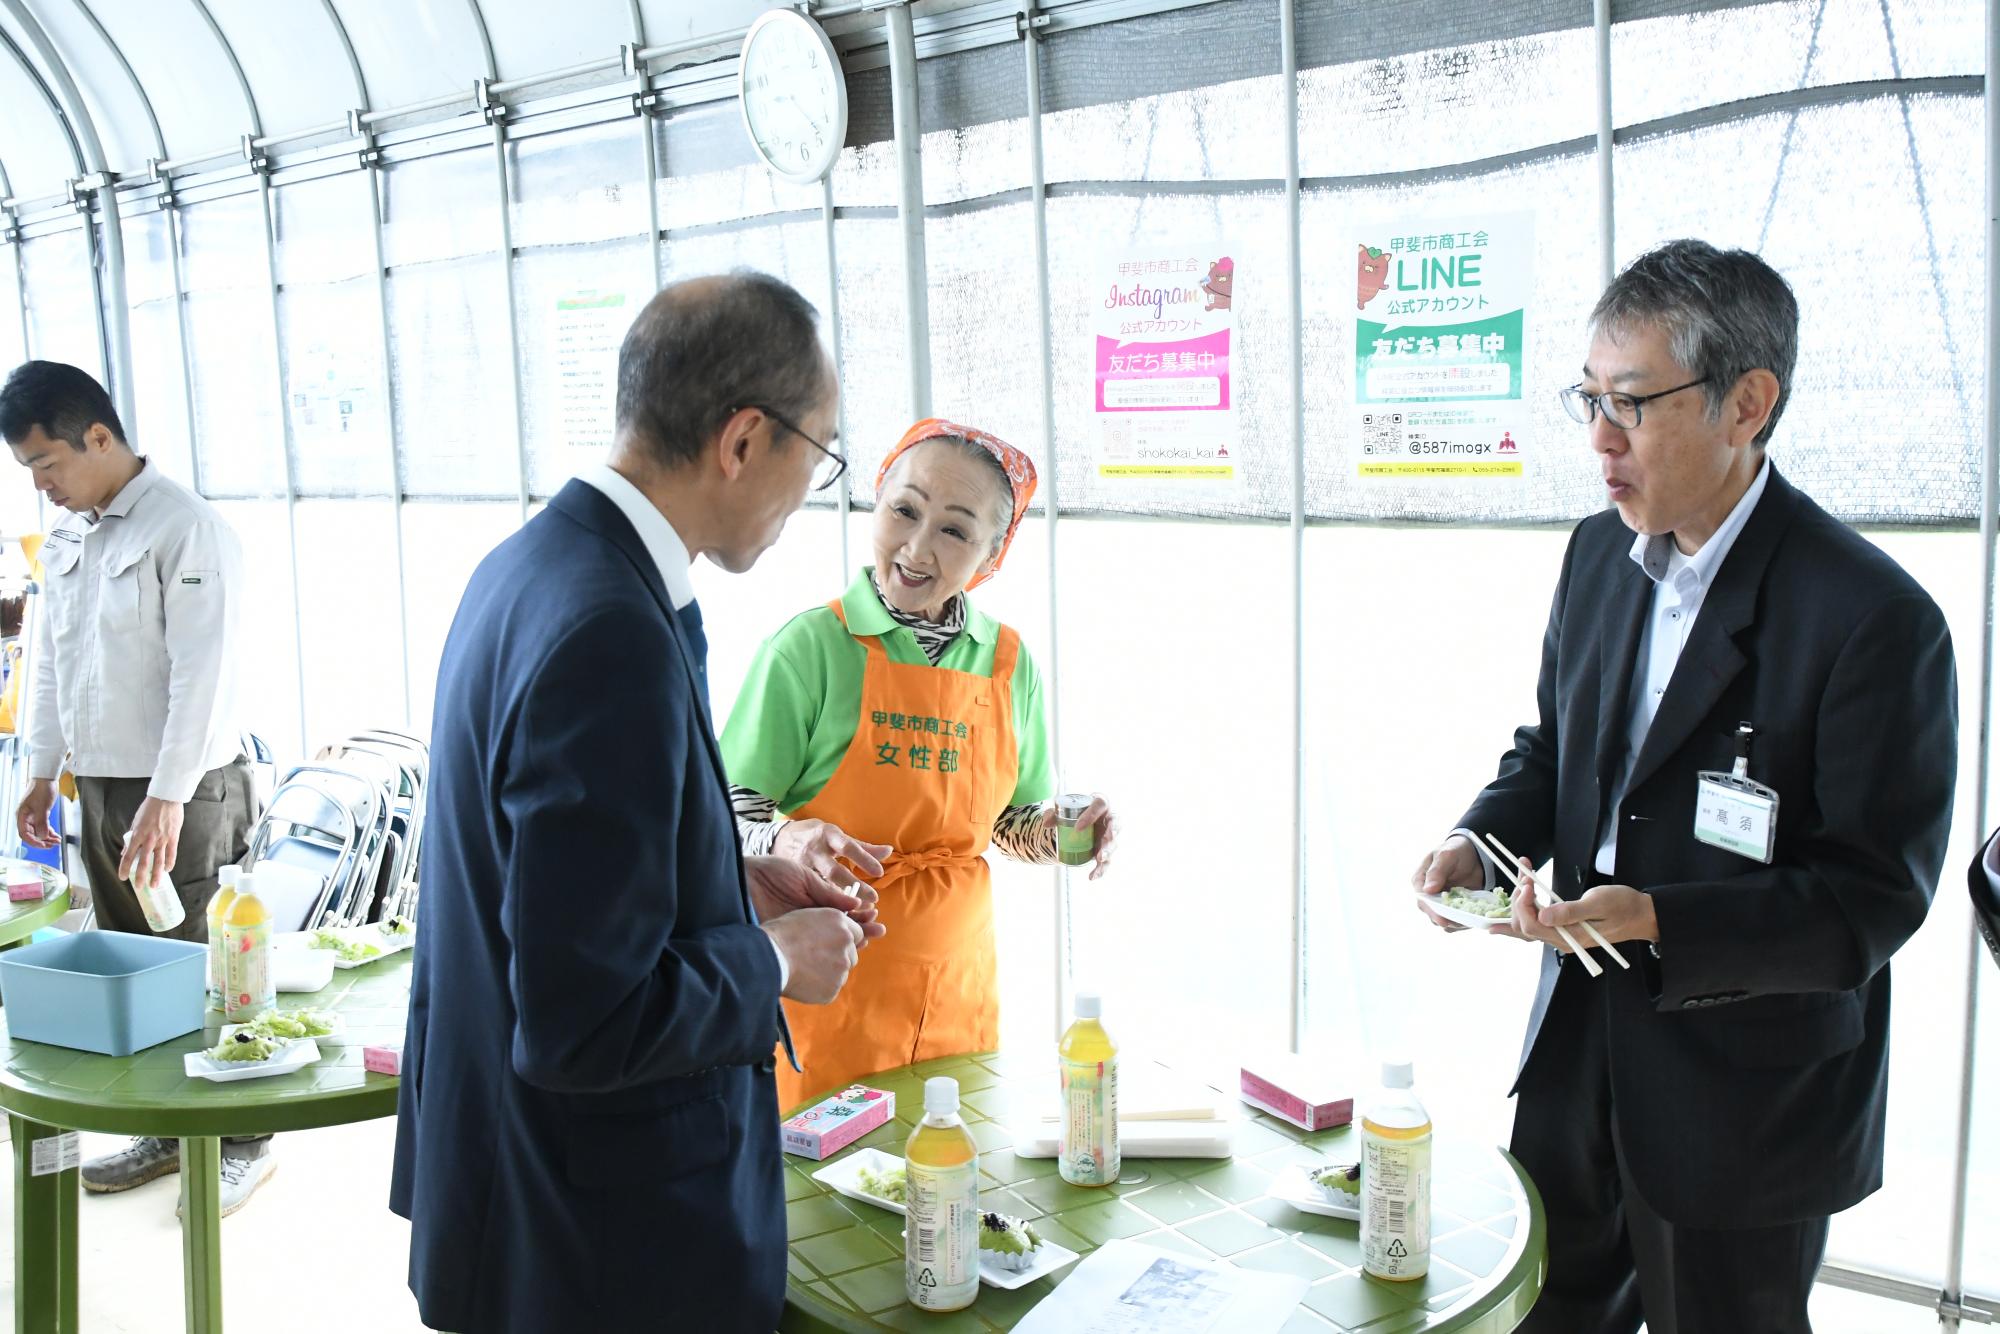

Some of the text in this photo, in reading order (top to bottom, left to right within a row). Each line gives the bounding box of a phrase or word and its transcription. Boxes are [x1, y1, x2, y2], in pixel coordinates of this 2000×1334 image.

[808, 48, 818, 70] 2
[784, 140, 792, 161] 7
[799, 142, 810, 162] 6
[1389, 230, 1489, 253] 甲斐市商工会
[1118, 258, 1200, 278] 甲斐市商工会
[1397, 254, 1483, 291] LINE
[1104, 283, 1200, 319] Instagram
[1387, 294, 1490, 315] 公式アカウント
[1119, 318, 1202, 335] 公式アカウント
[1371, 333, 1505, 361] 友だち募集中
[1108, 351, 1216, 373] 友だち募集中
[1137, 446, 1214, 460] shokokai_kai
[1408, 441, 1492, 455] @587imogx
[871, 710, 968, 739] 甲斐市商工会
[875, 741, 960, 774] 女性部
